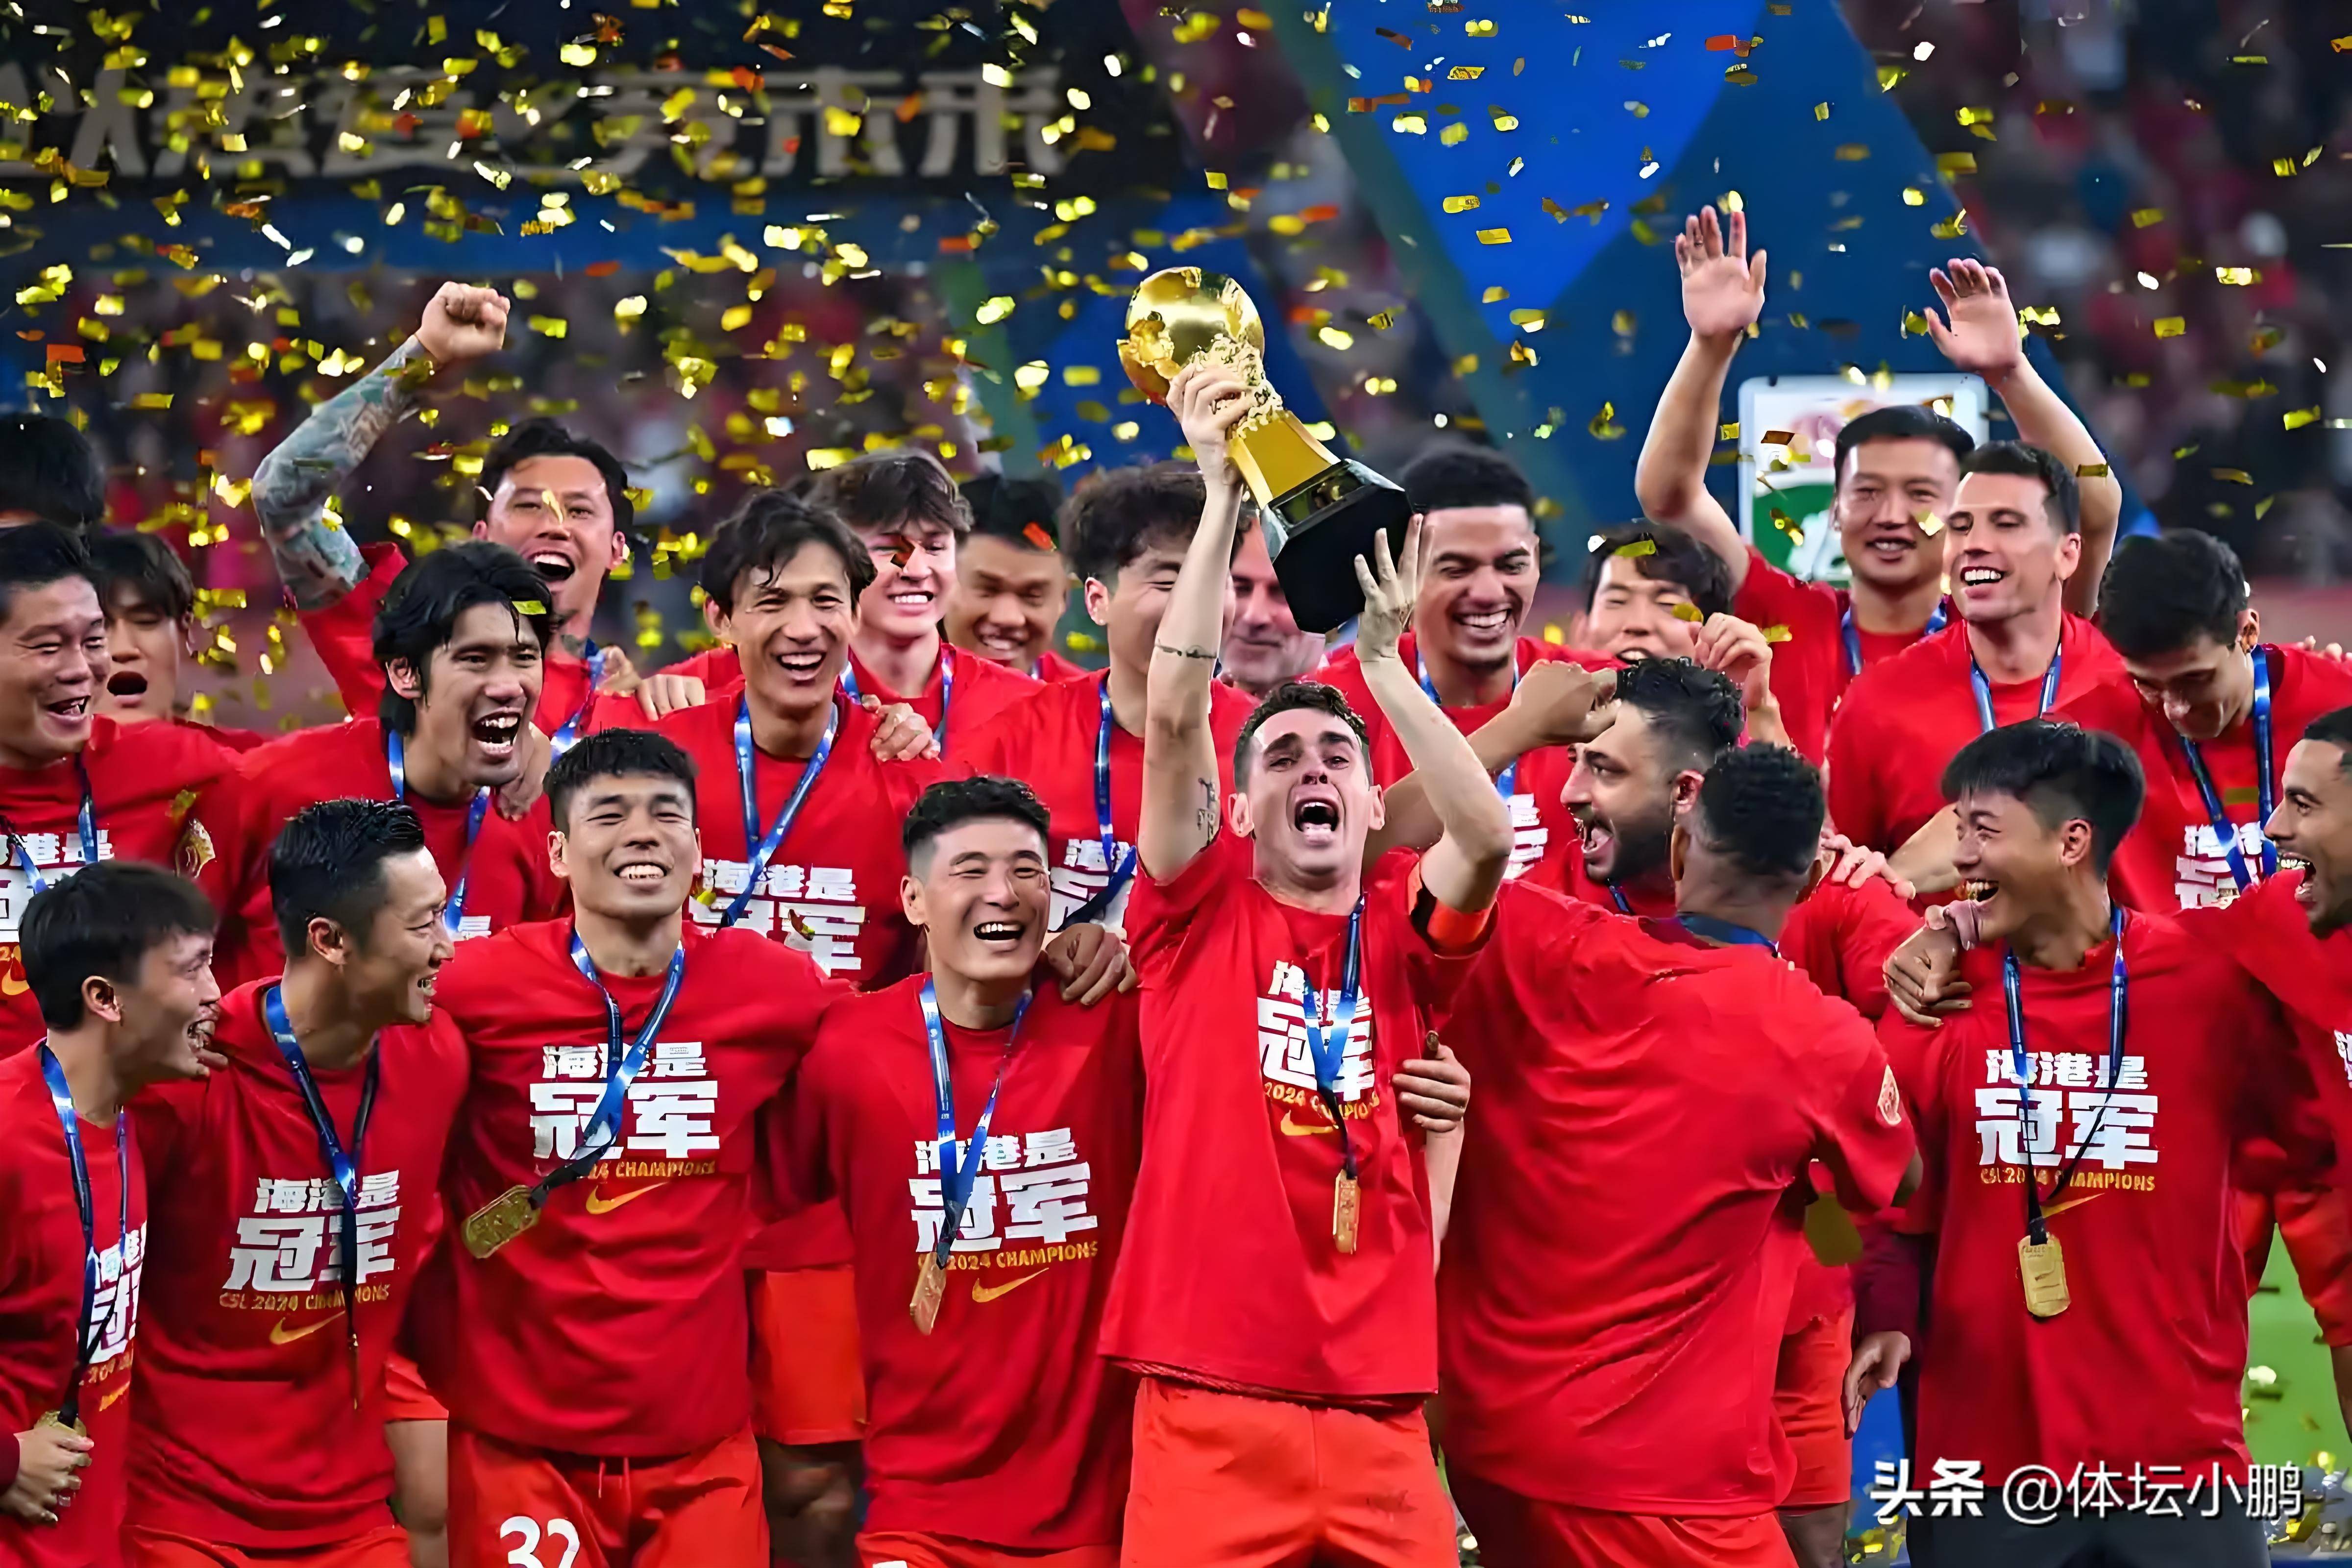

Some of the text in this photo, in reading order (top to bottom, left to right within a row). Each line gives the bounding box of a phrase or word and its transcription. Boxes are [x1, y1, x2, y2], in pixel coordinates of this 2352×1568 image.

[1975, 1087, 2158, 1170] 冠军
[221, 1205, 403, 1292] 冠军
[908, 1161, 1098, 1253] 冠军
[996, 1241, 1098, 1268] CHAMPIONS
